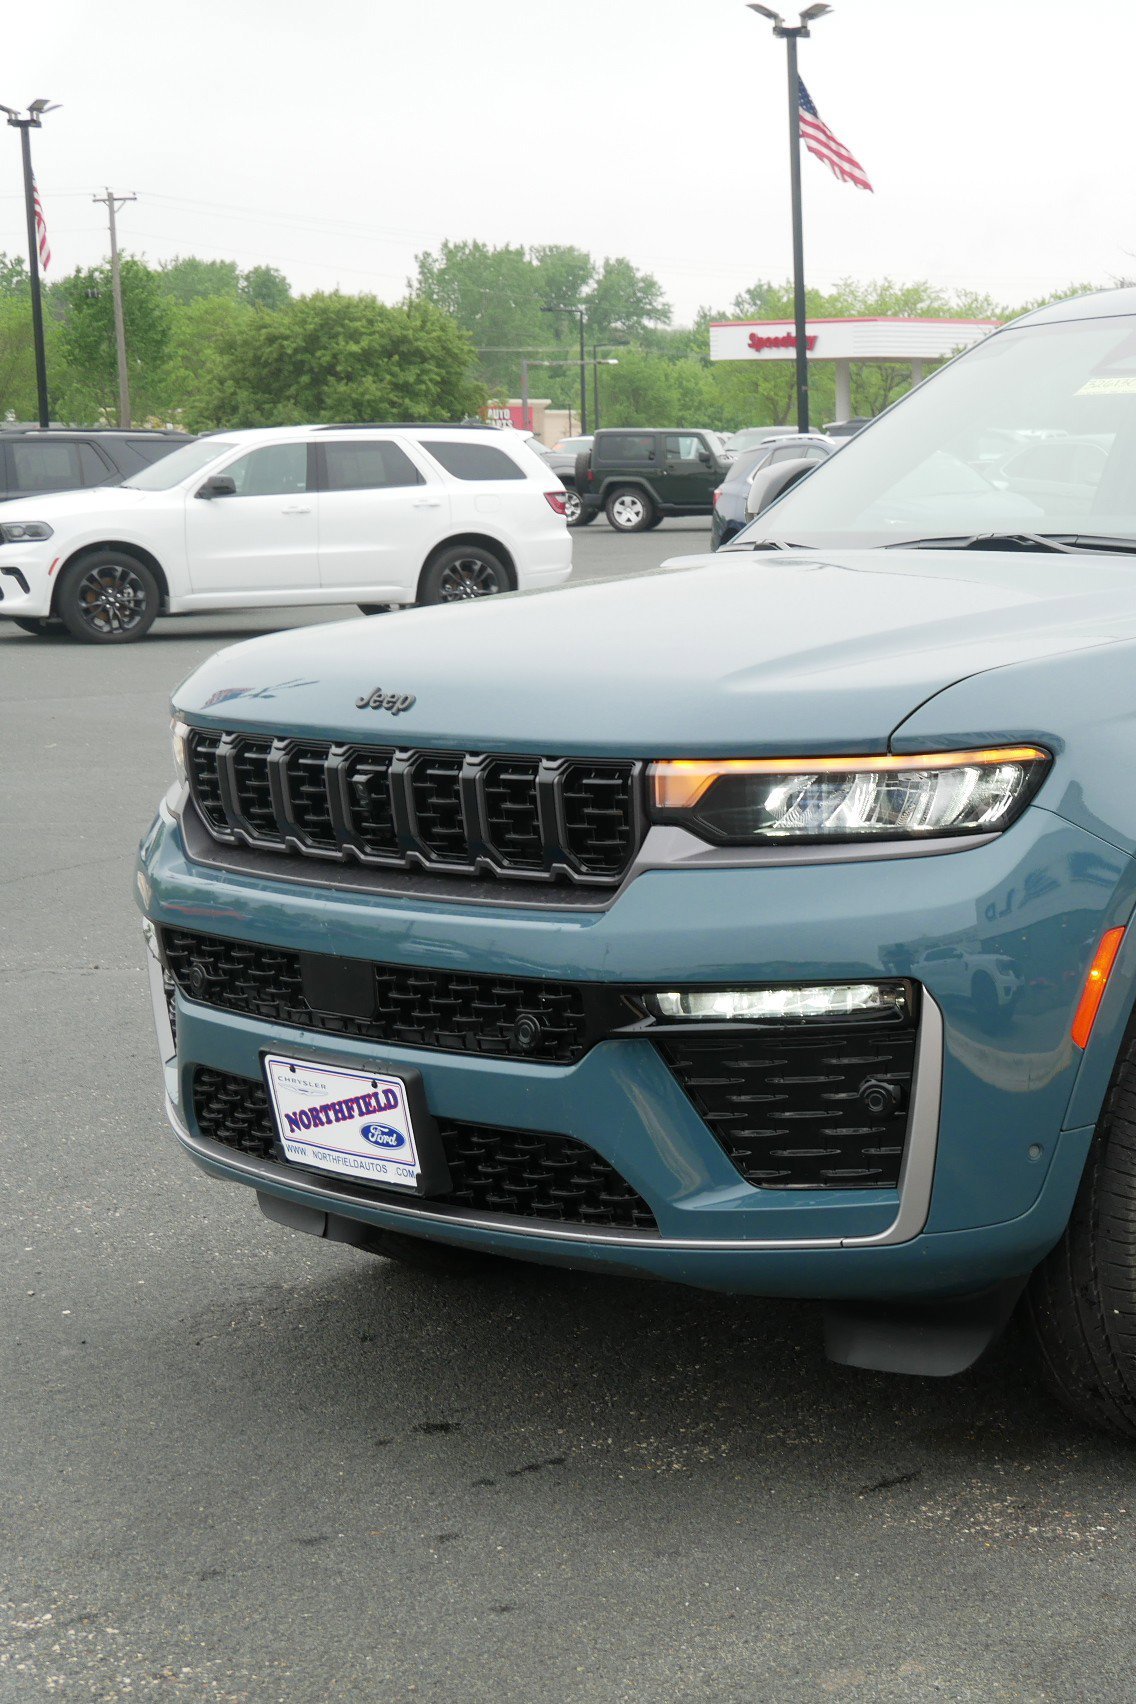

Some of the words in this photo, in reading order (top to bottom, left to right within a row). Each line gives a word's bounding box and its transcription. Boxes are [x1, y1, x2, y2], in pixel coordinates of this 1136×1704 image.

[747, 332, 818, 352] Speedwy
[487, 408, 511, 420] AUTO
[355, 686, 416, 716] Jeep
[277, 1075, 327, 1090] CHRYSLER
[284, 1088, 400, 1134] NORTHFIELD
[367, 1125, 398, 1147] Ford
[312, 1149, 389, 1174] NORTHFIELDAUTOS
